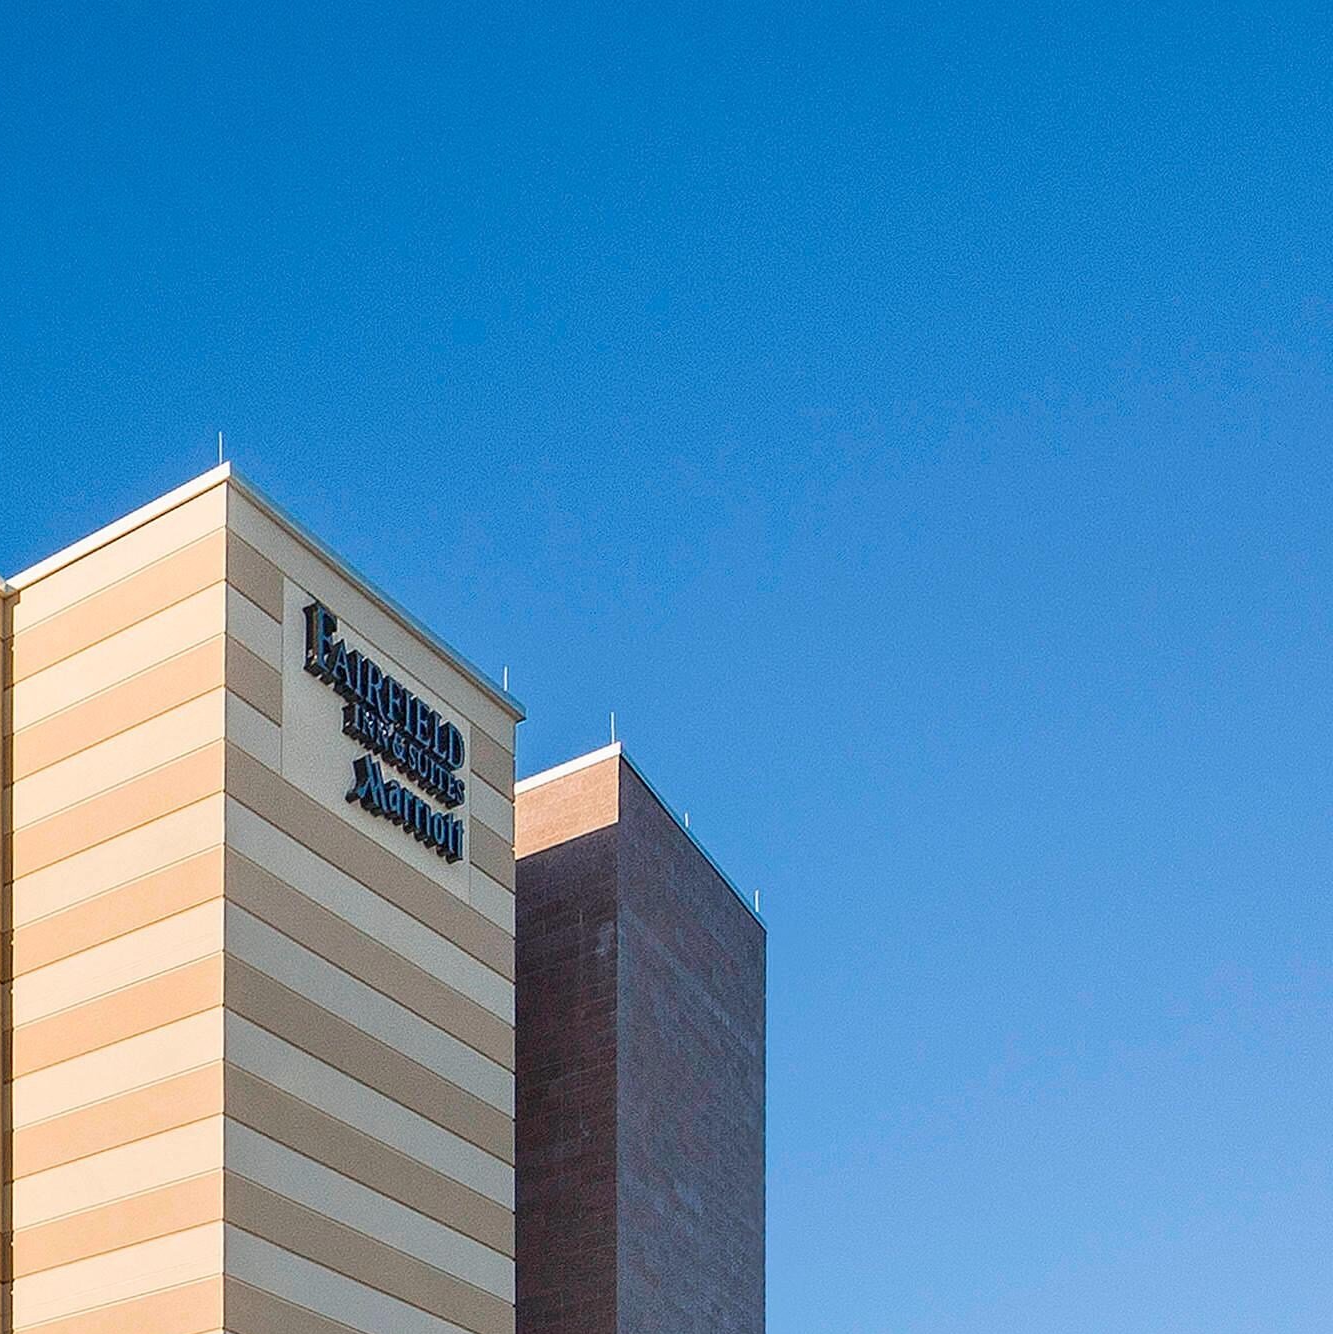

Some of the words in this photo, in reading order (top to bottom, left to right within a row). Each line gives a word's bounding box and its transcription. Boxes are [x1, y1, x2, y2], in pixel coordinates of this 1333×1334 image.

[303, 601, 465, 771] FAIRFIELD
[345, 753, 464, 864] Marriott
[401, 744, 465, 810] SUITES
